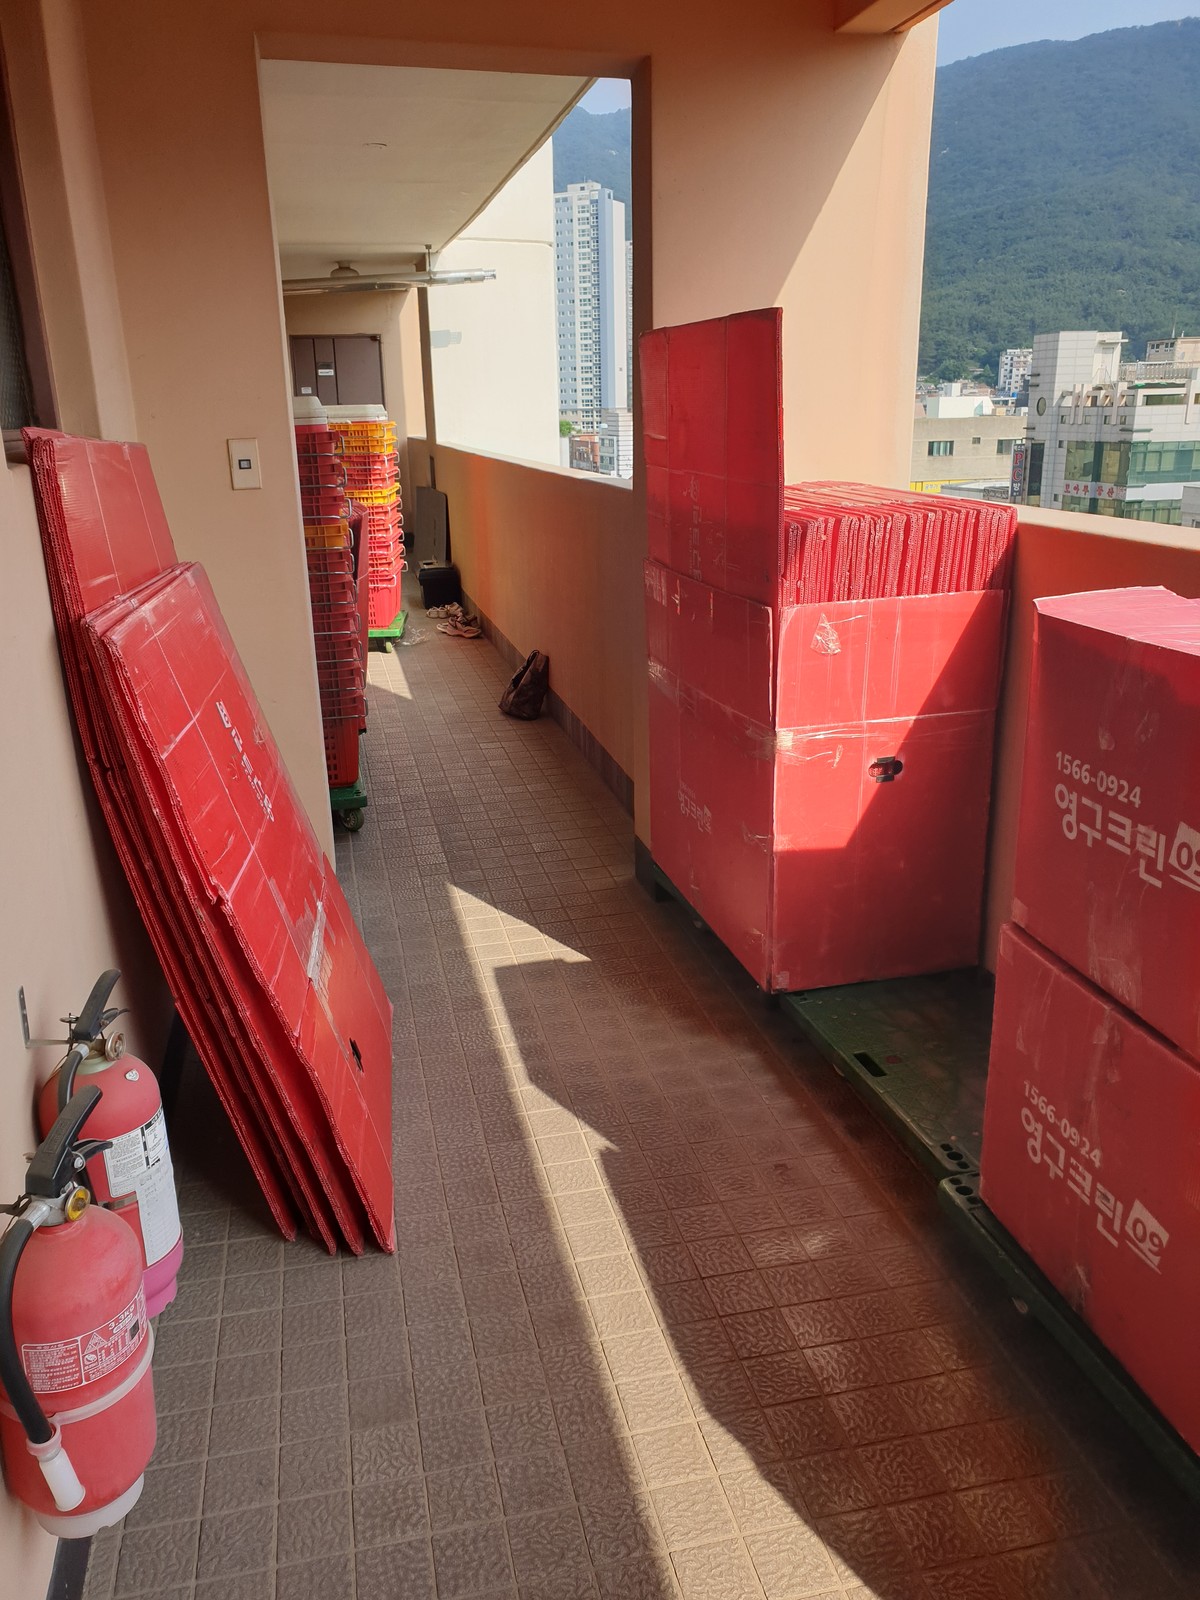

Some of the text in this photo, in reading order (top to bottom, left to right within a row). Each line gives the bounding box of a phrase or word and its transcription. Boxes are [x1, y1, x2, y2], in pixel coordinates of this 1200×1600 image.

[1055, 751, 1142, 808] 1566-0924
[1054, 783, 1167, 889] 영구크린
[1023, 1080, 1102, 1168] 1566-0924
[1020, 1107, 1124, 1248] 영구크린
